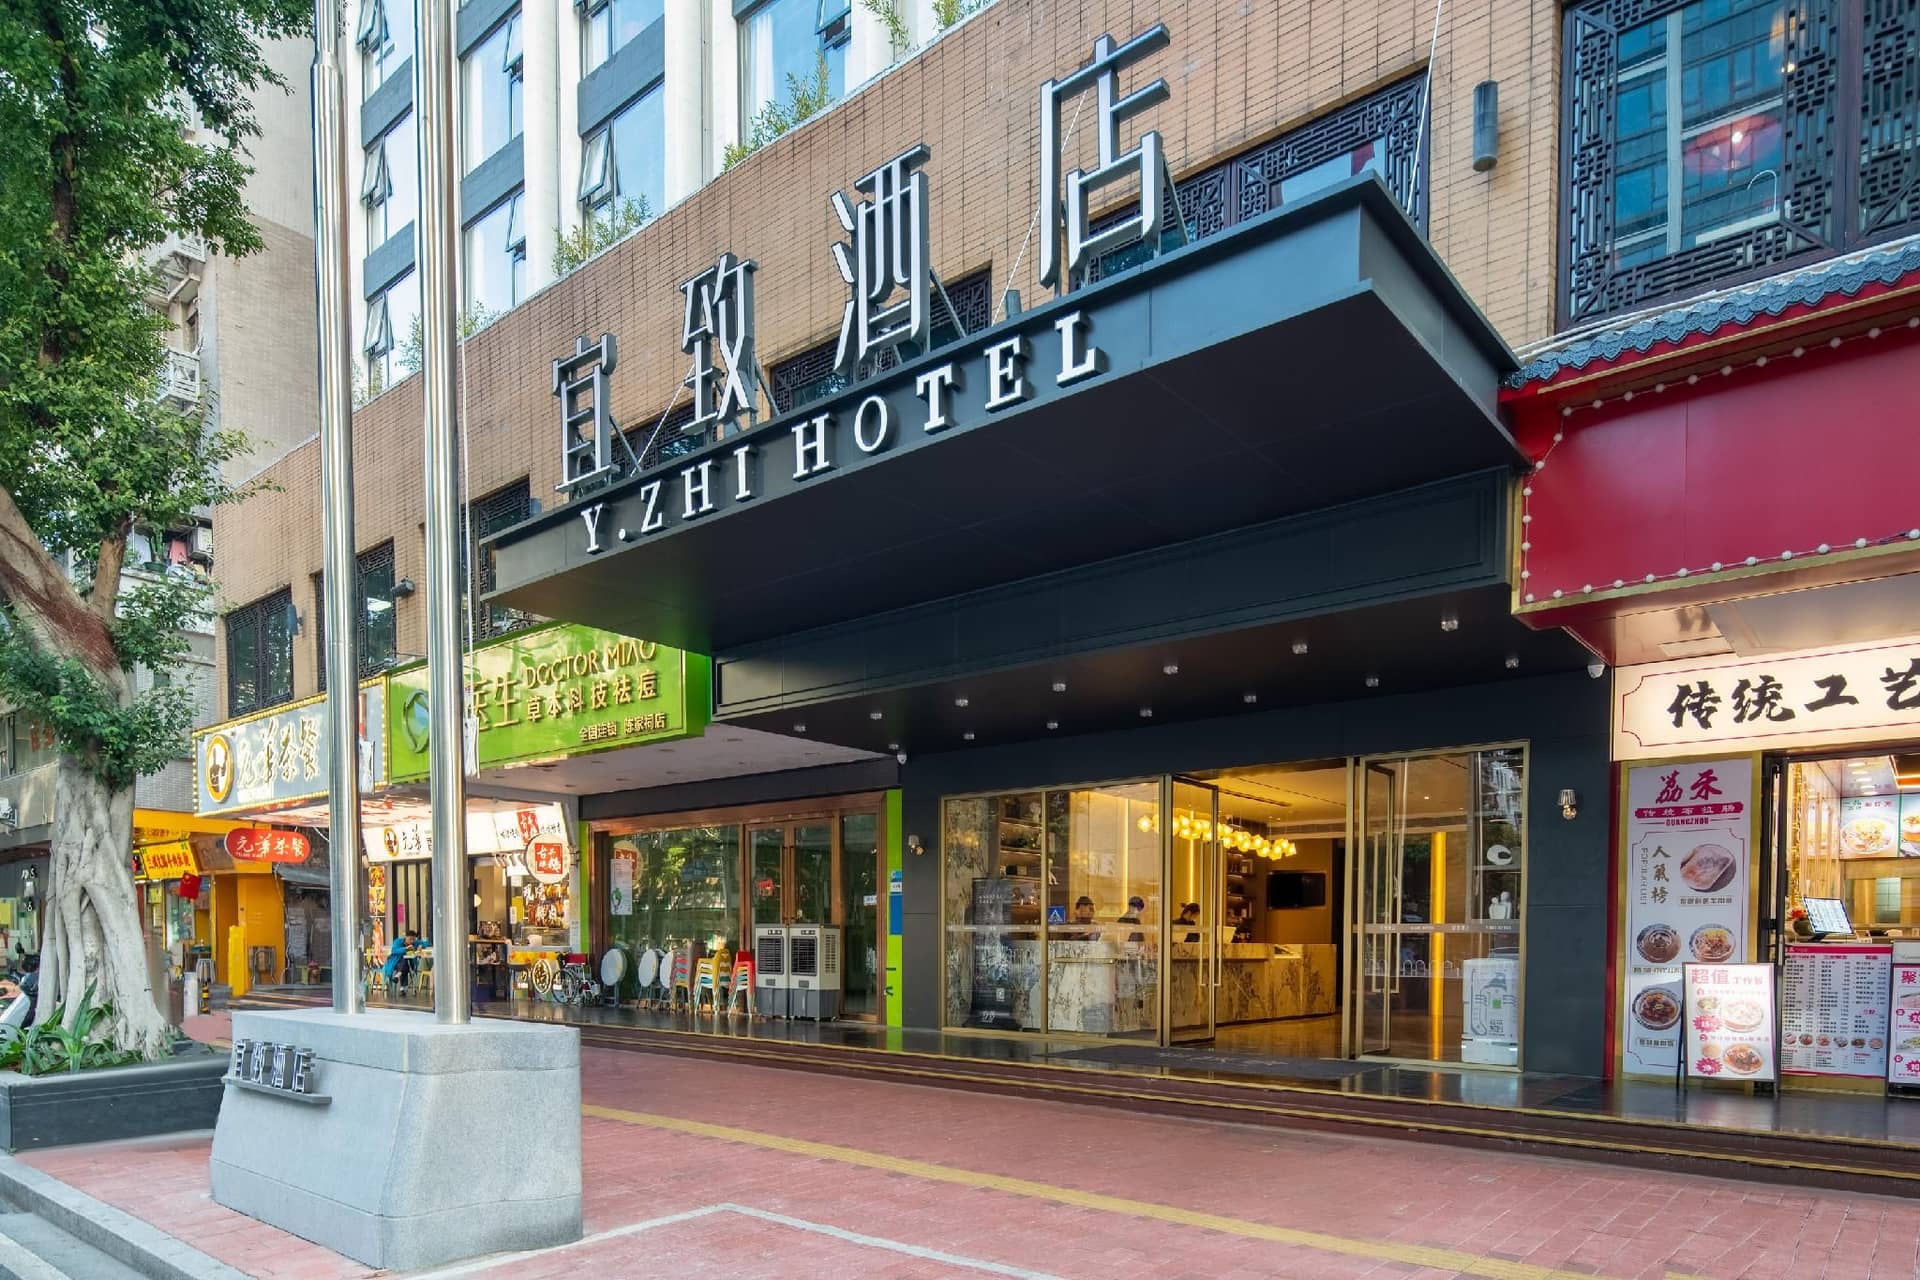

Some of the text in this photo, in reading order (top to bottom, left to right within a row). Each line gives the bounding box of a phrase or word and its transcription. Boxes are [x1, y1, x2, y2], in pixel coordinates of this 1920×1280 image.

[581, 310, 1106, 555] Y.ZHI HOTEL
[524, 649, 599, 690] DOCTOR
[526, 669, 658, 723] 草本科技祛痘
[1667, 657, 1920, 730] 传统工艺
[1690, 967, 1730, 985] 超值
